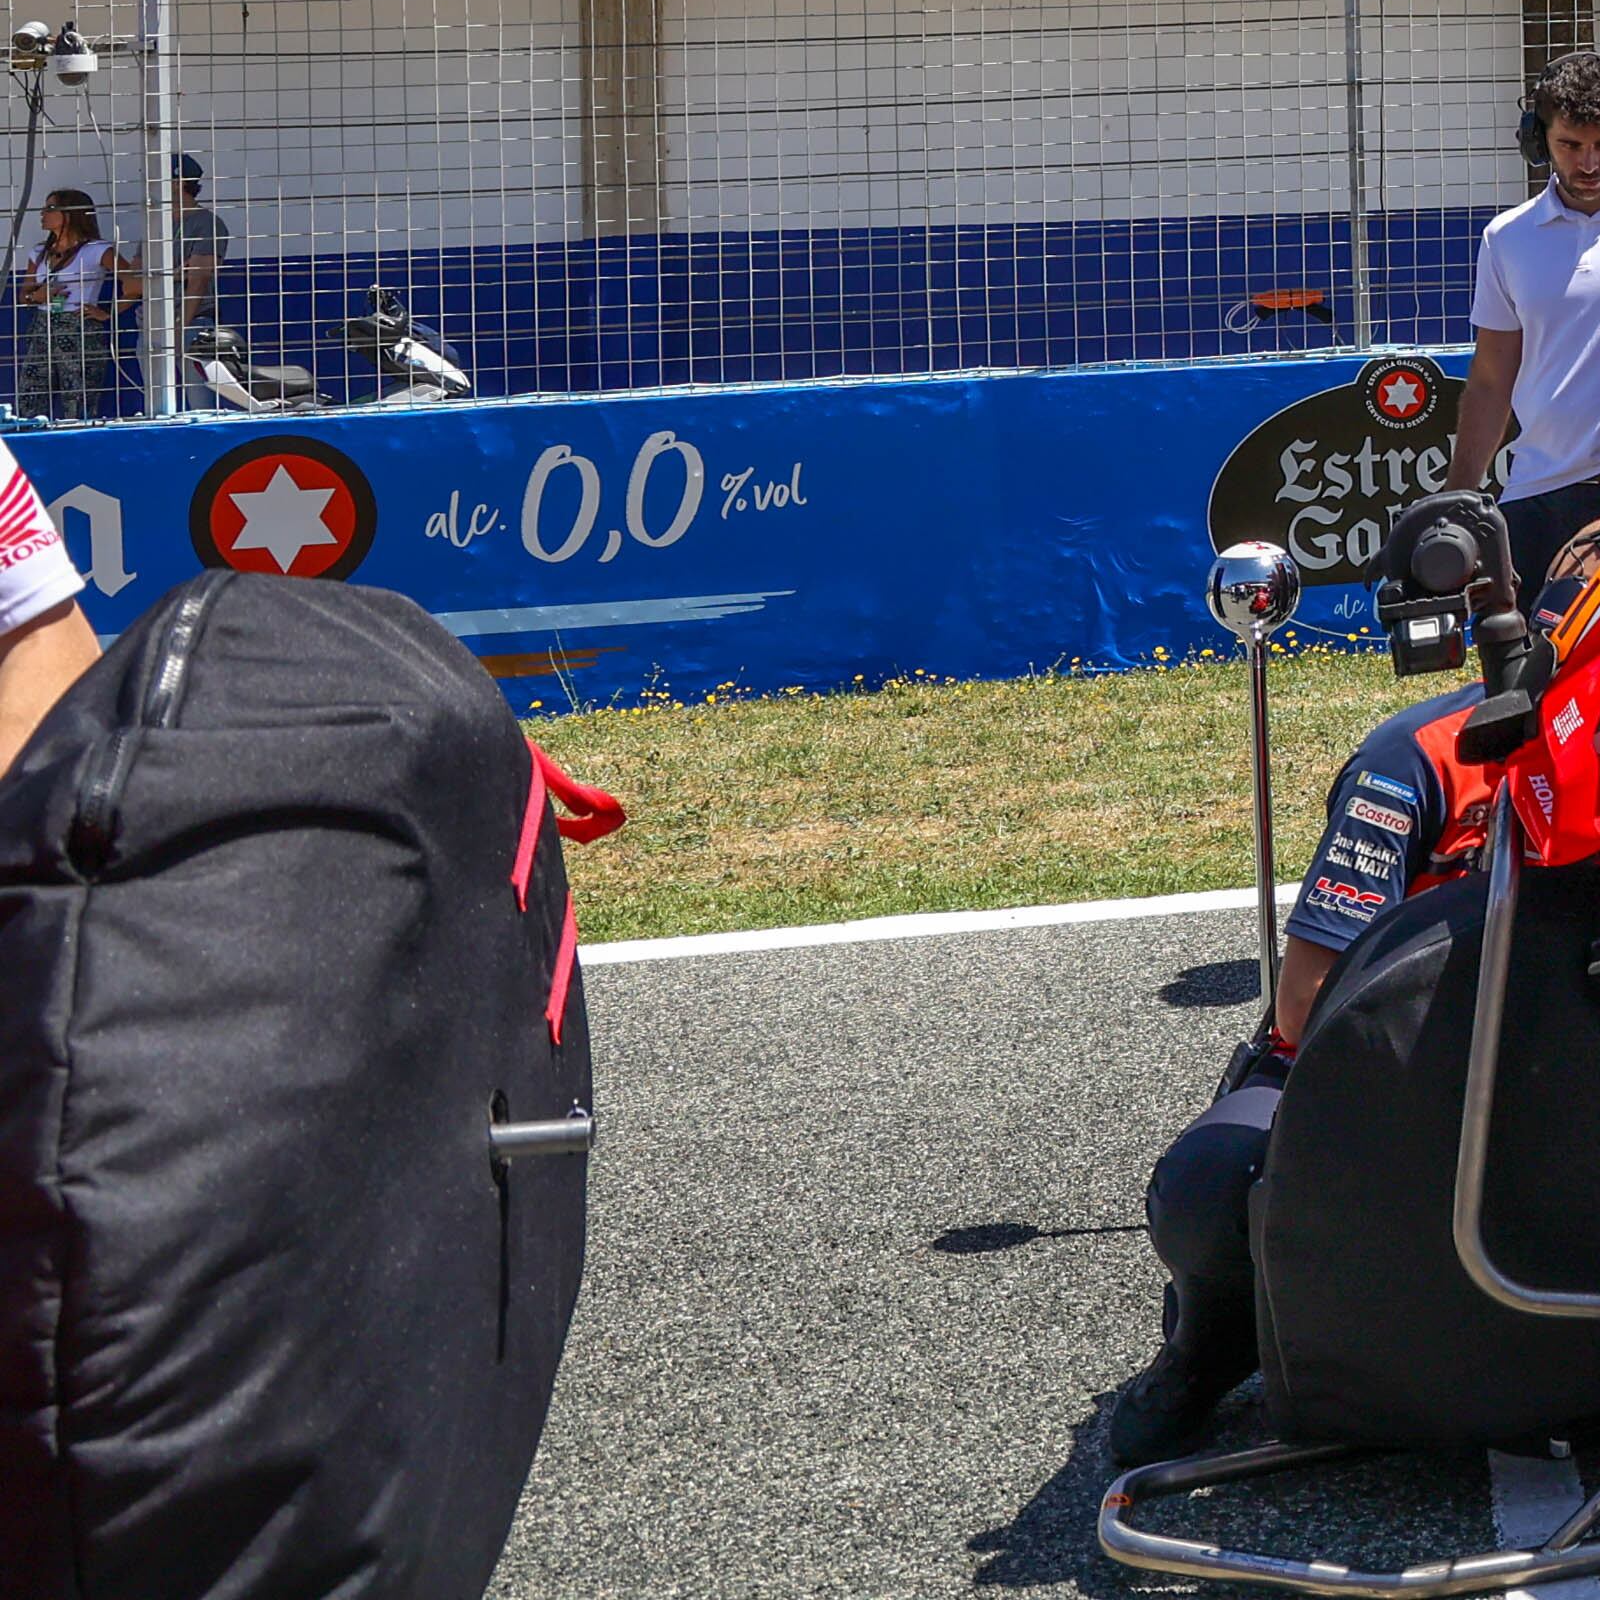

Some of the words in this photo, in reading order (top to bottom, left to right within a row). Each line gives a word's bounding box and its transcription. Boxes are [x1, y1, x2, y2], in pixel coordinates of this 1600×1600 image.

[1367, 360, 1397, 386] ESTRELLA
[1396, 359, 1425, 373] GALICIA
[1275, 433, 1514, 503] Estre
[425, 489, 507, 548] alc.
[521, 430, 704, 565] 0,0
[1333, 593, 1368, 619] alc.
[1372, 776, 1416, 800] MICHELIN
[1527, 773, 1554, 826] HON
[1355, 802, 1411, 833] Castrol
[1307, 876, 1386, 917] HRC
